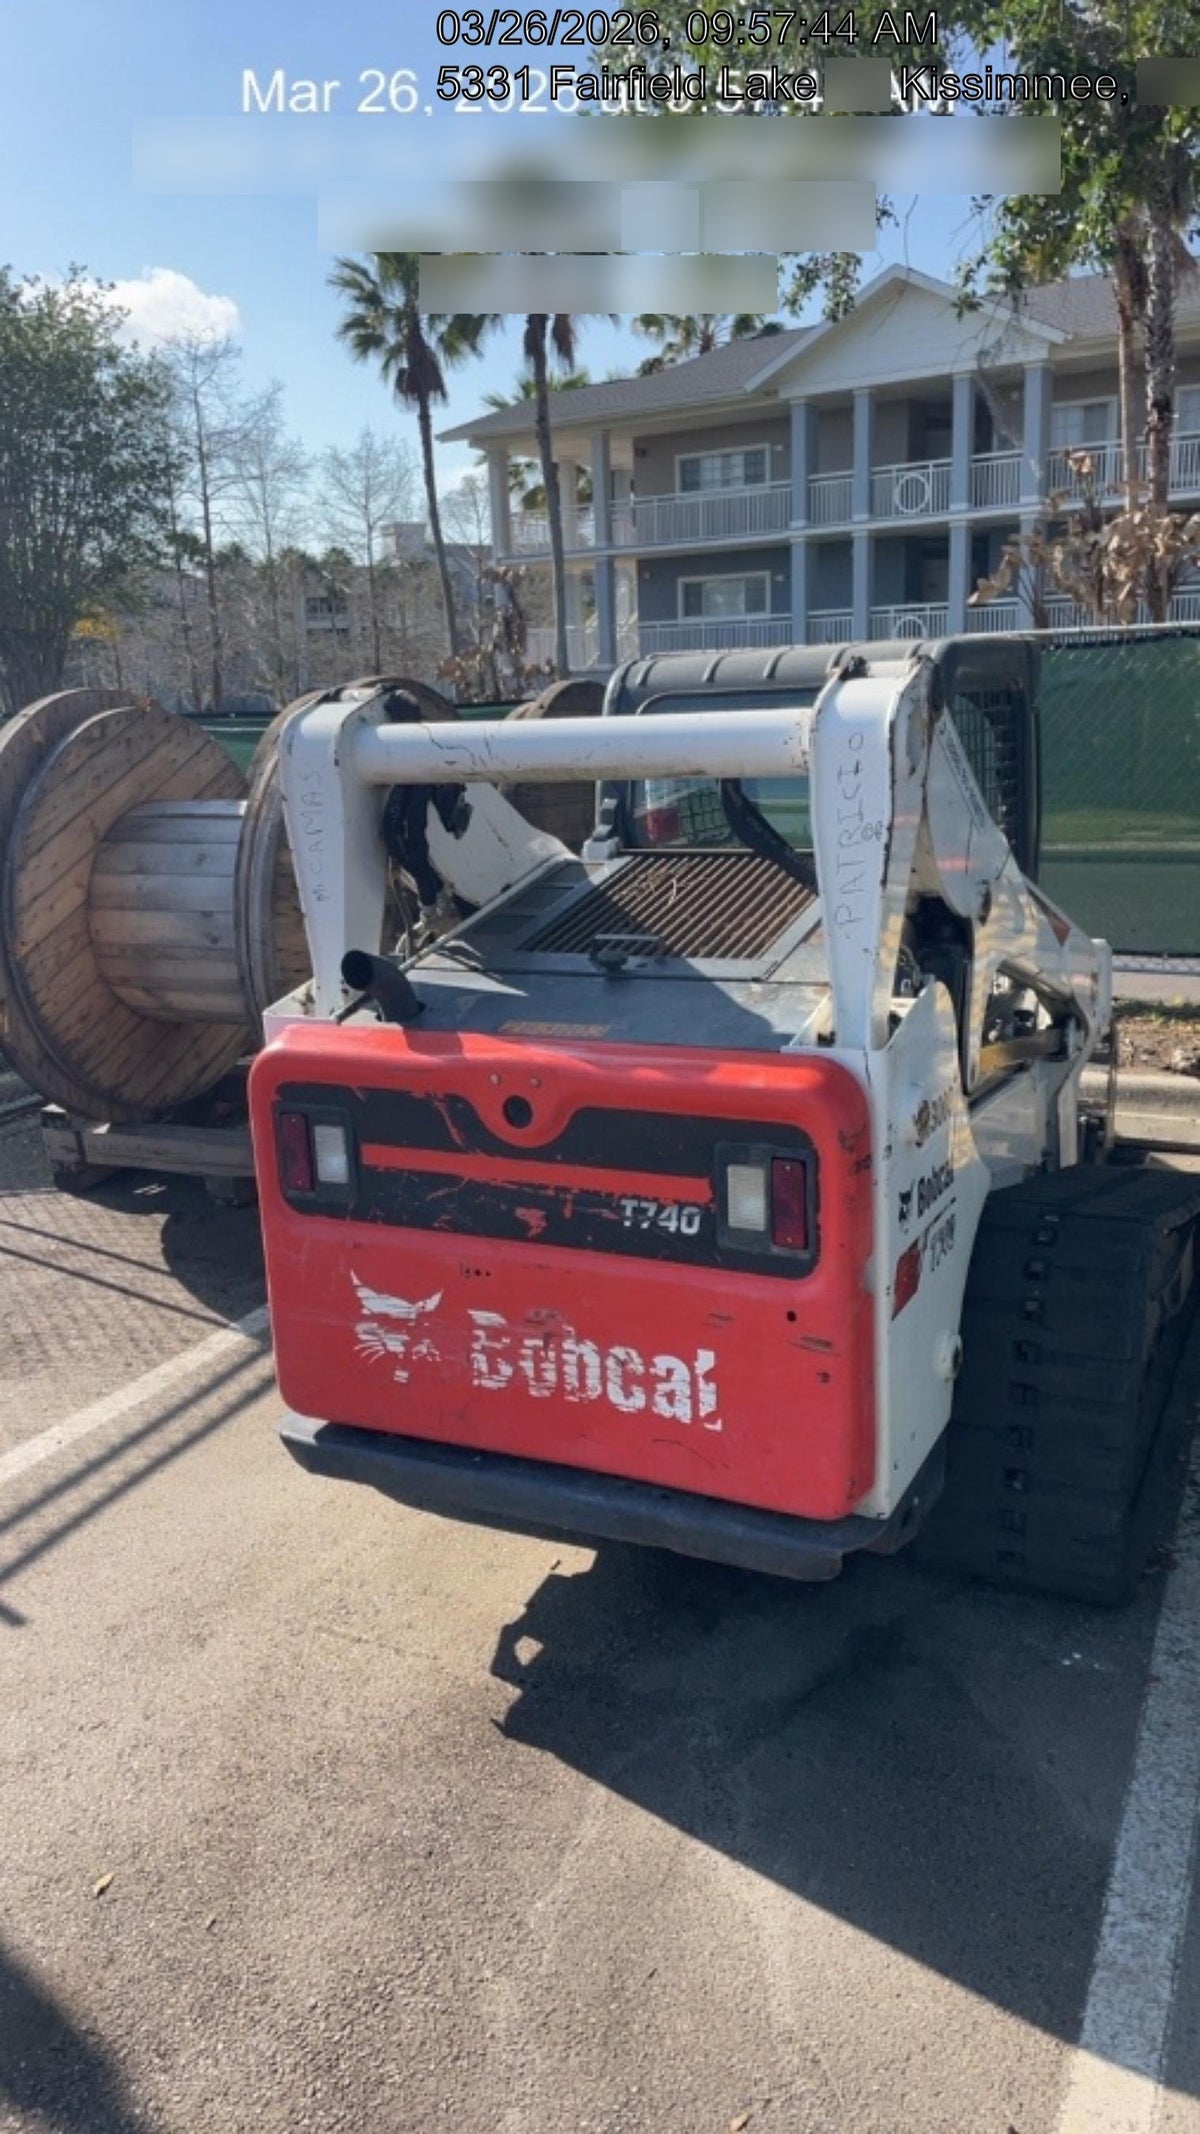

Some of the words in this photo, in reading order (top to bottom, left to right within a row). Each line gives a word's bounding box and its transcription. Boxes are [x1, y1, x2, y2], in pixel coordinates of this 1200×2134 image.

[833, 732, 865, 933] PATRICIO
[620, 1199, 701, 1235] T740
[467, 1308, 722, 1432] Bobcat
